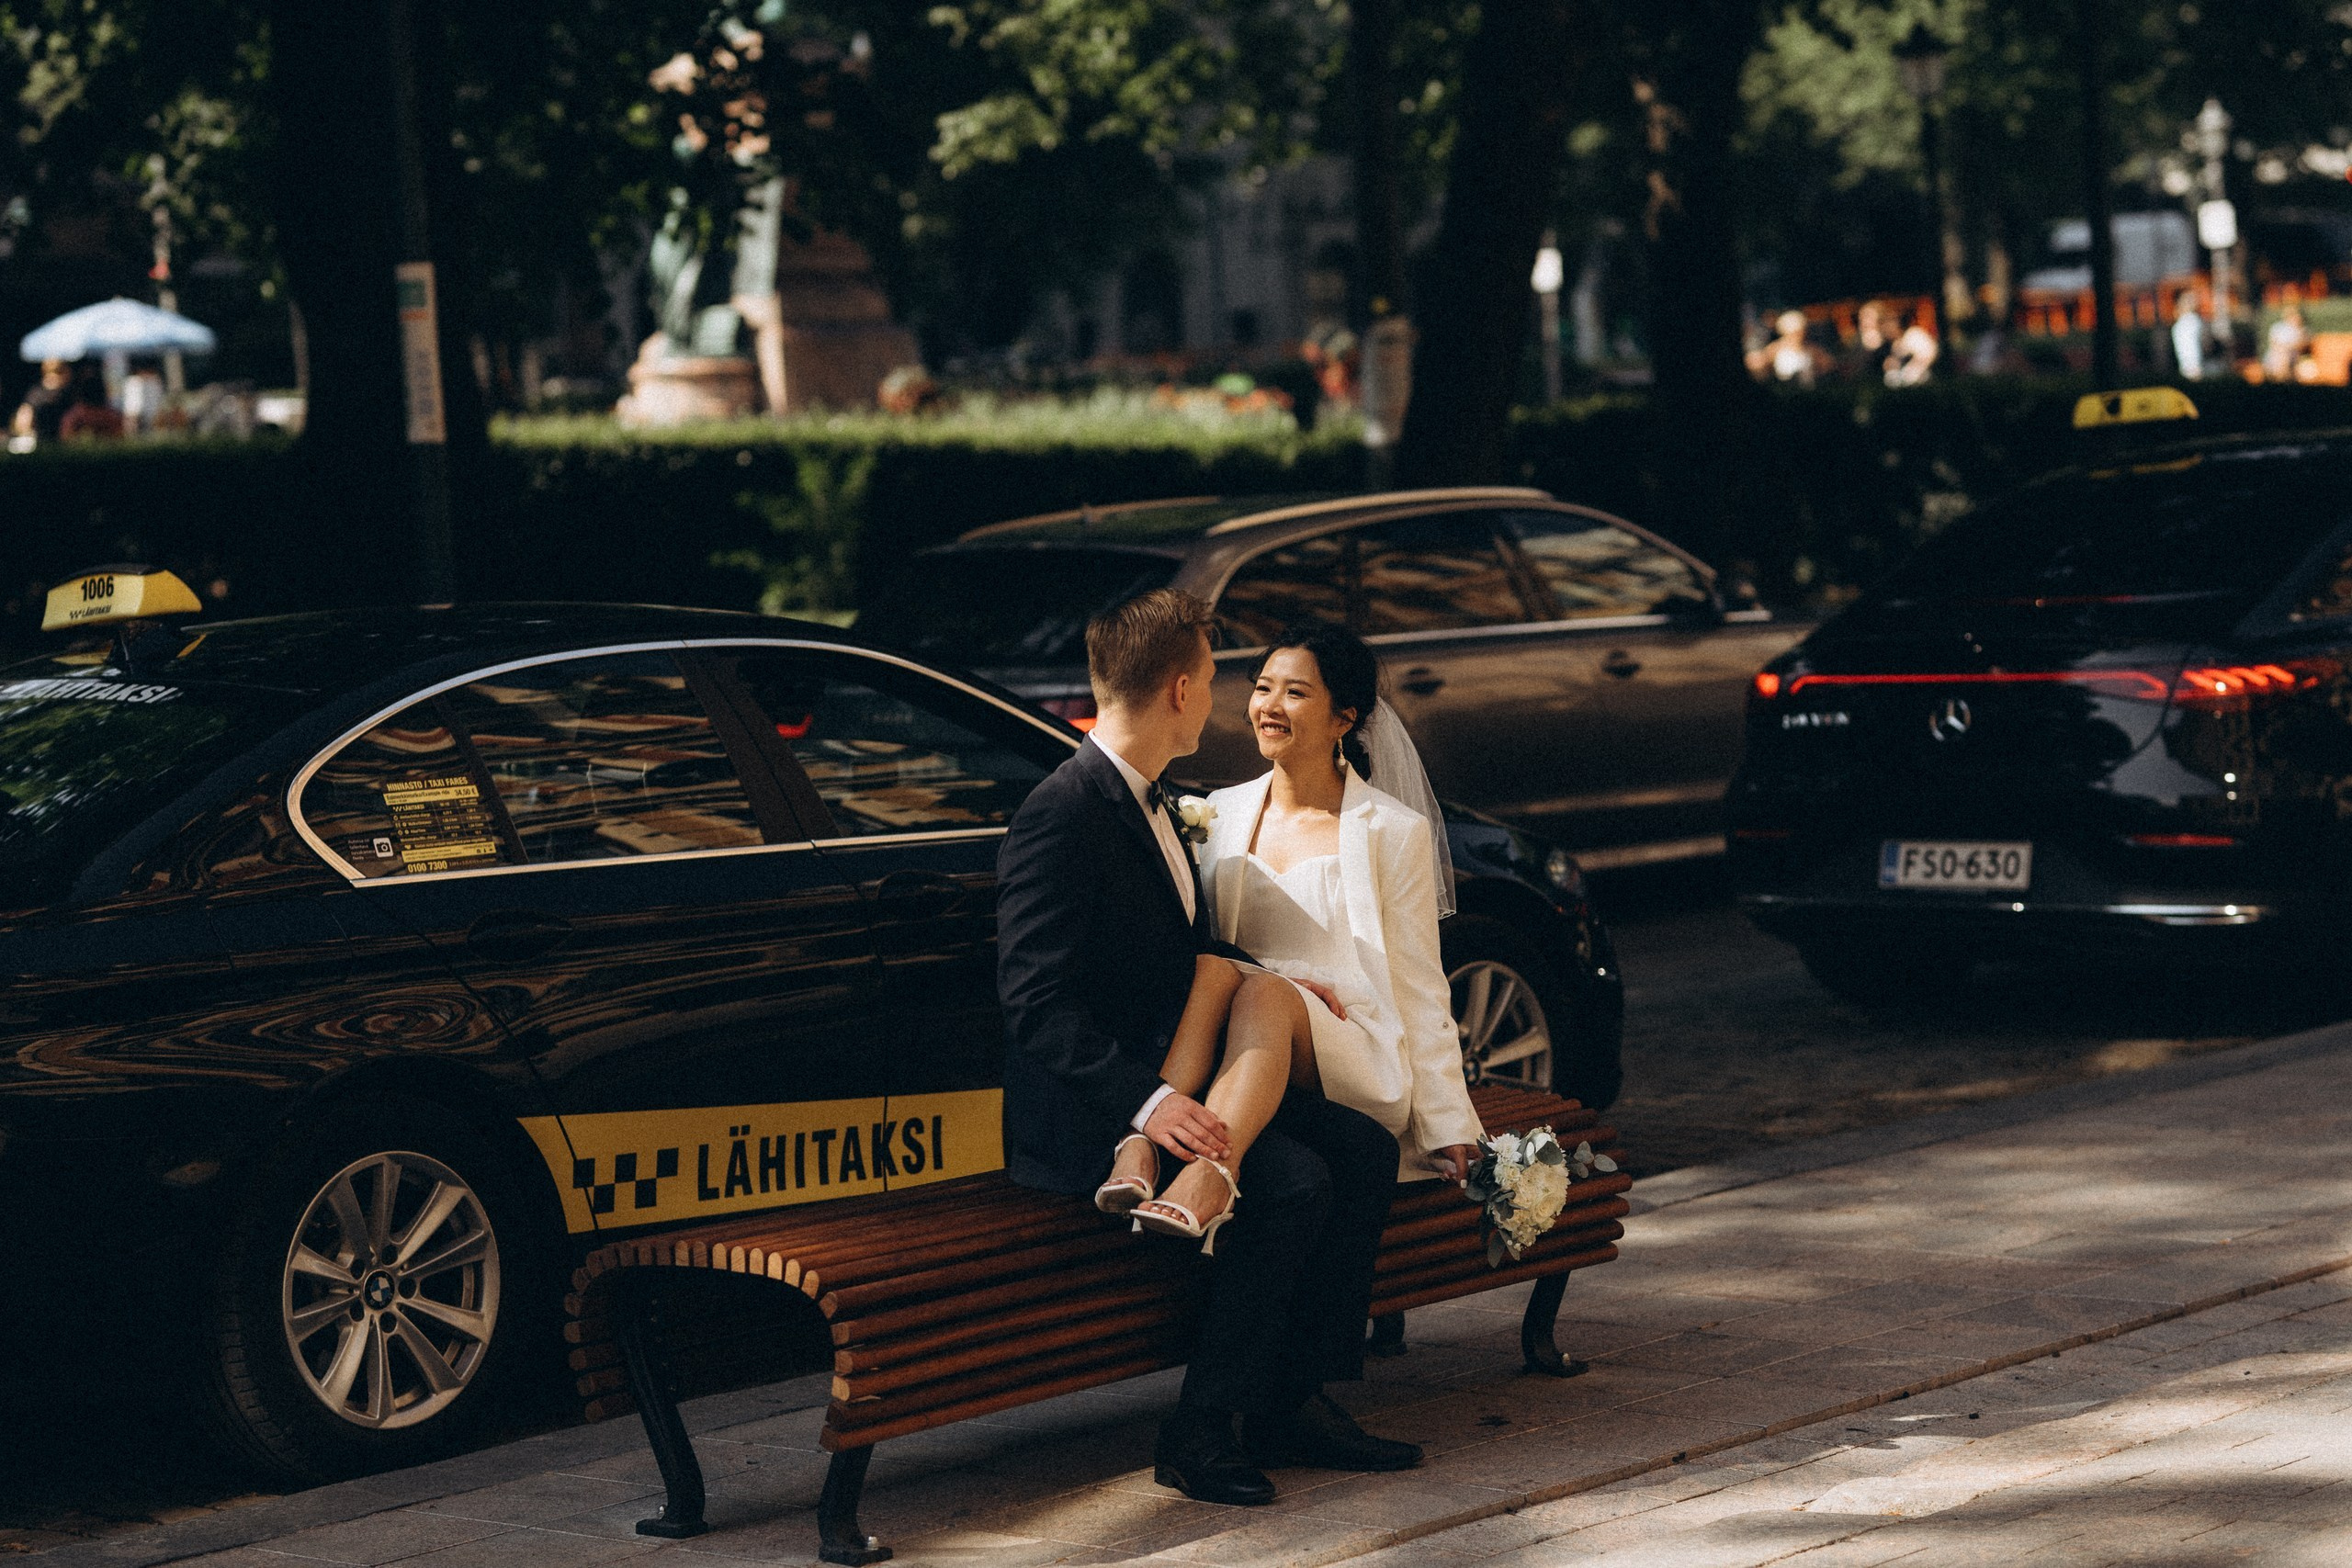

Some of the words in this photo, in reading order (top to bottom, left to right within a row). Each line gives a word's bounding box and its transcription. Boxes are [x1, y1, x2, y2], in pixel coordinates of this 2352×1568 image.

[81, 576, 114, 602] 1006
[387, 781, 423, 791] HINNASTO
[429, 778, 445, 788] TAXI
[446, 776, 468, 786] FARES
[407, 863, 427, 873] 0100
[428, 860, 448, 871] 7300
[696, 1114, 944, 1201] LÄHITAKSI
